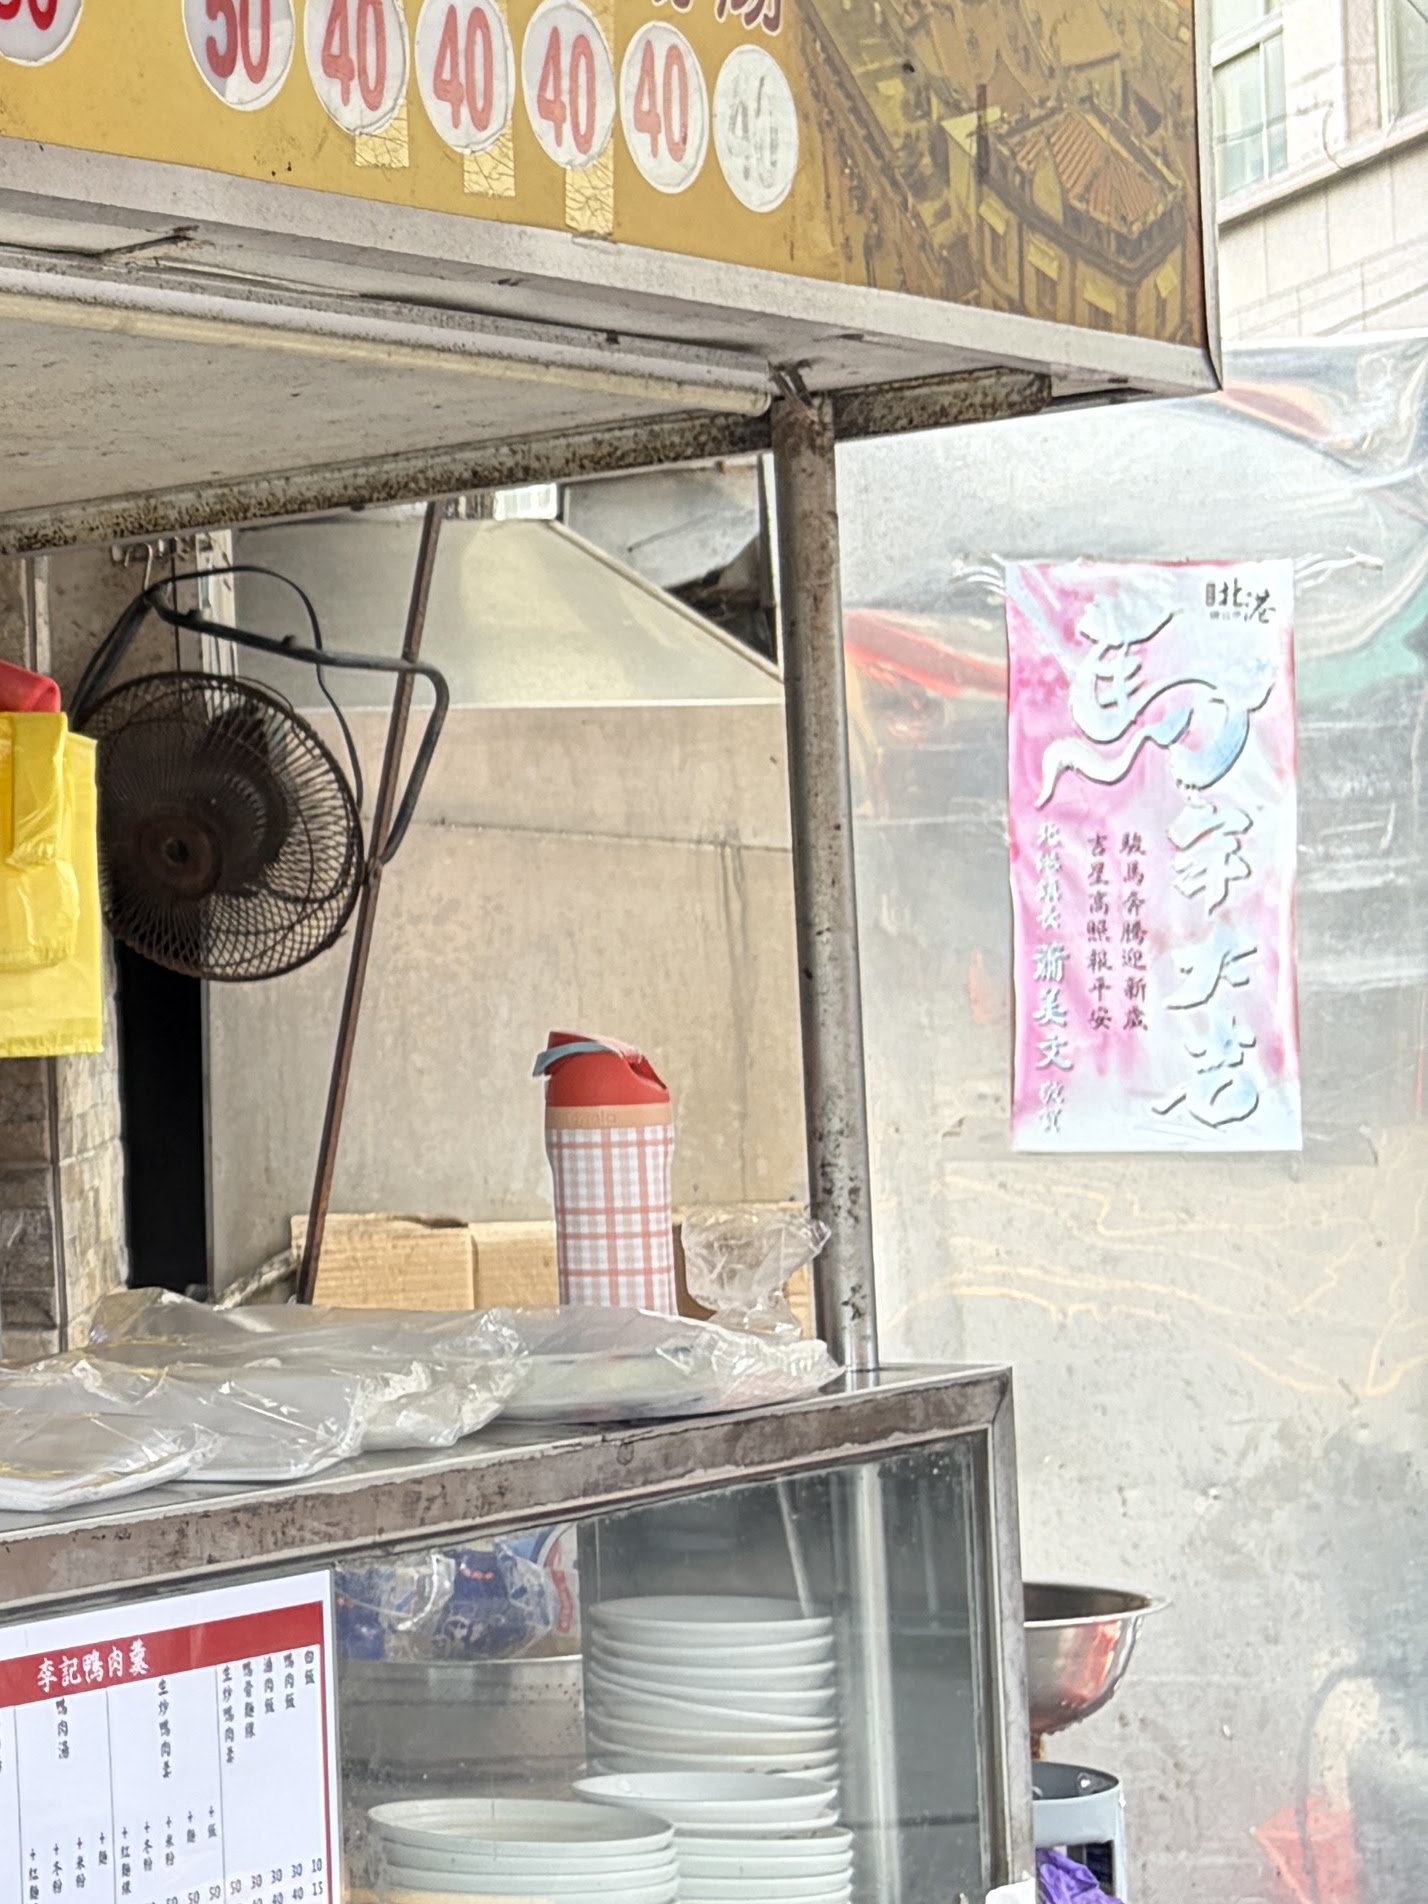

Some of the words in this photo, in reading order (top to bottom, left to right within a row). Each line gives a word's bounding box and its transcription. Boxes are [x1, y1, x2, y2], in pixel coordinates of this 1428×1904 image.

[433, 4, 493, 133] 40
[538, 26, 595, 154] 40
[633, 40, 687, 163] 40
[1087, 834, 1112, 1030] 吉星高照報平安
[37, 1638, 149, 1693] 李記鴨肉羹
[55, 1698, 70, 1759] 鴨肉湯
[158, 1678, 172, 1778] 生炒鴨肉羹
[209, 1884, 221, 1901] 50
[230, 1879, 242, 1896] 50
[250, 1873, 262, 1890] 30
[271, 1868, 283, 1884] 30
[291, 1862, 303, 1879] 30
[312, 1857, 323, 1873] 10
[292, 1886, 304, 1901] 40
[312, 1881, 323, 1896] 15
